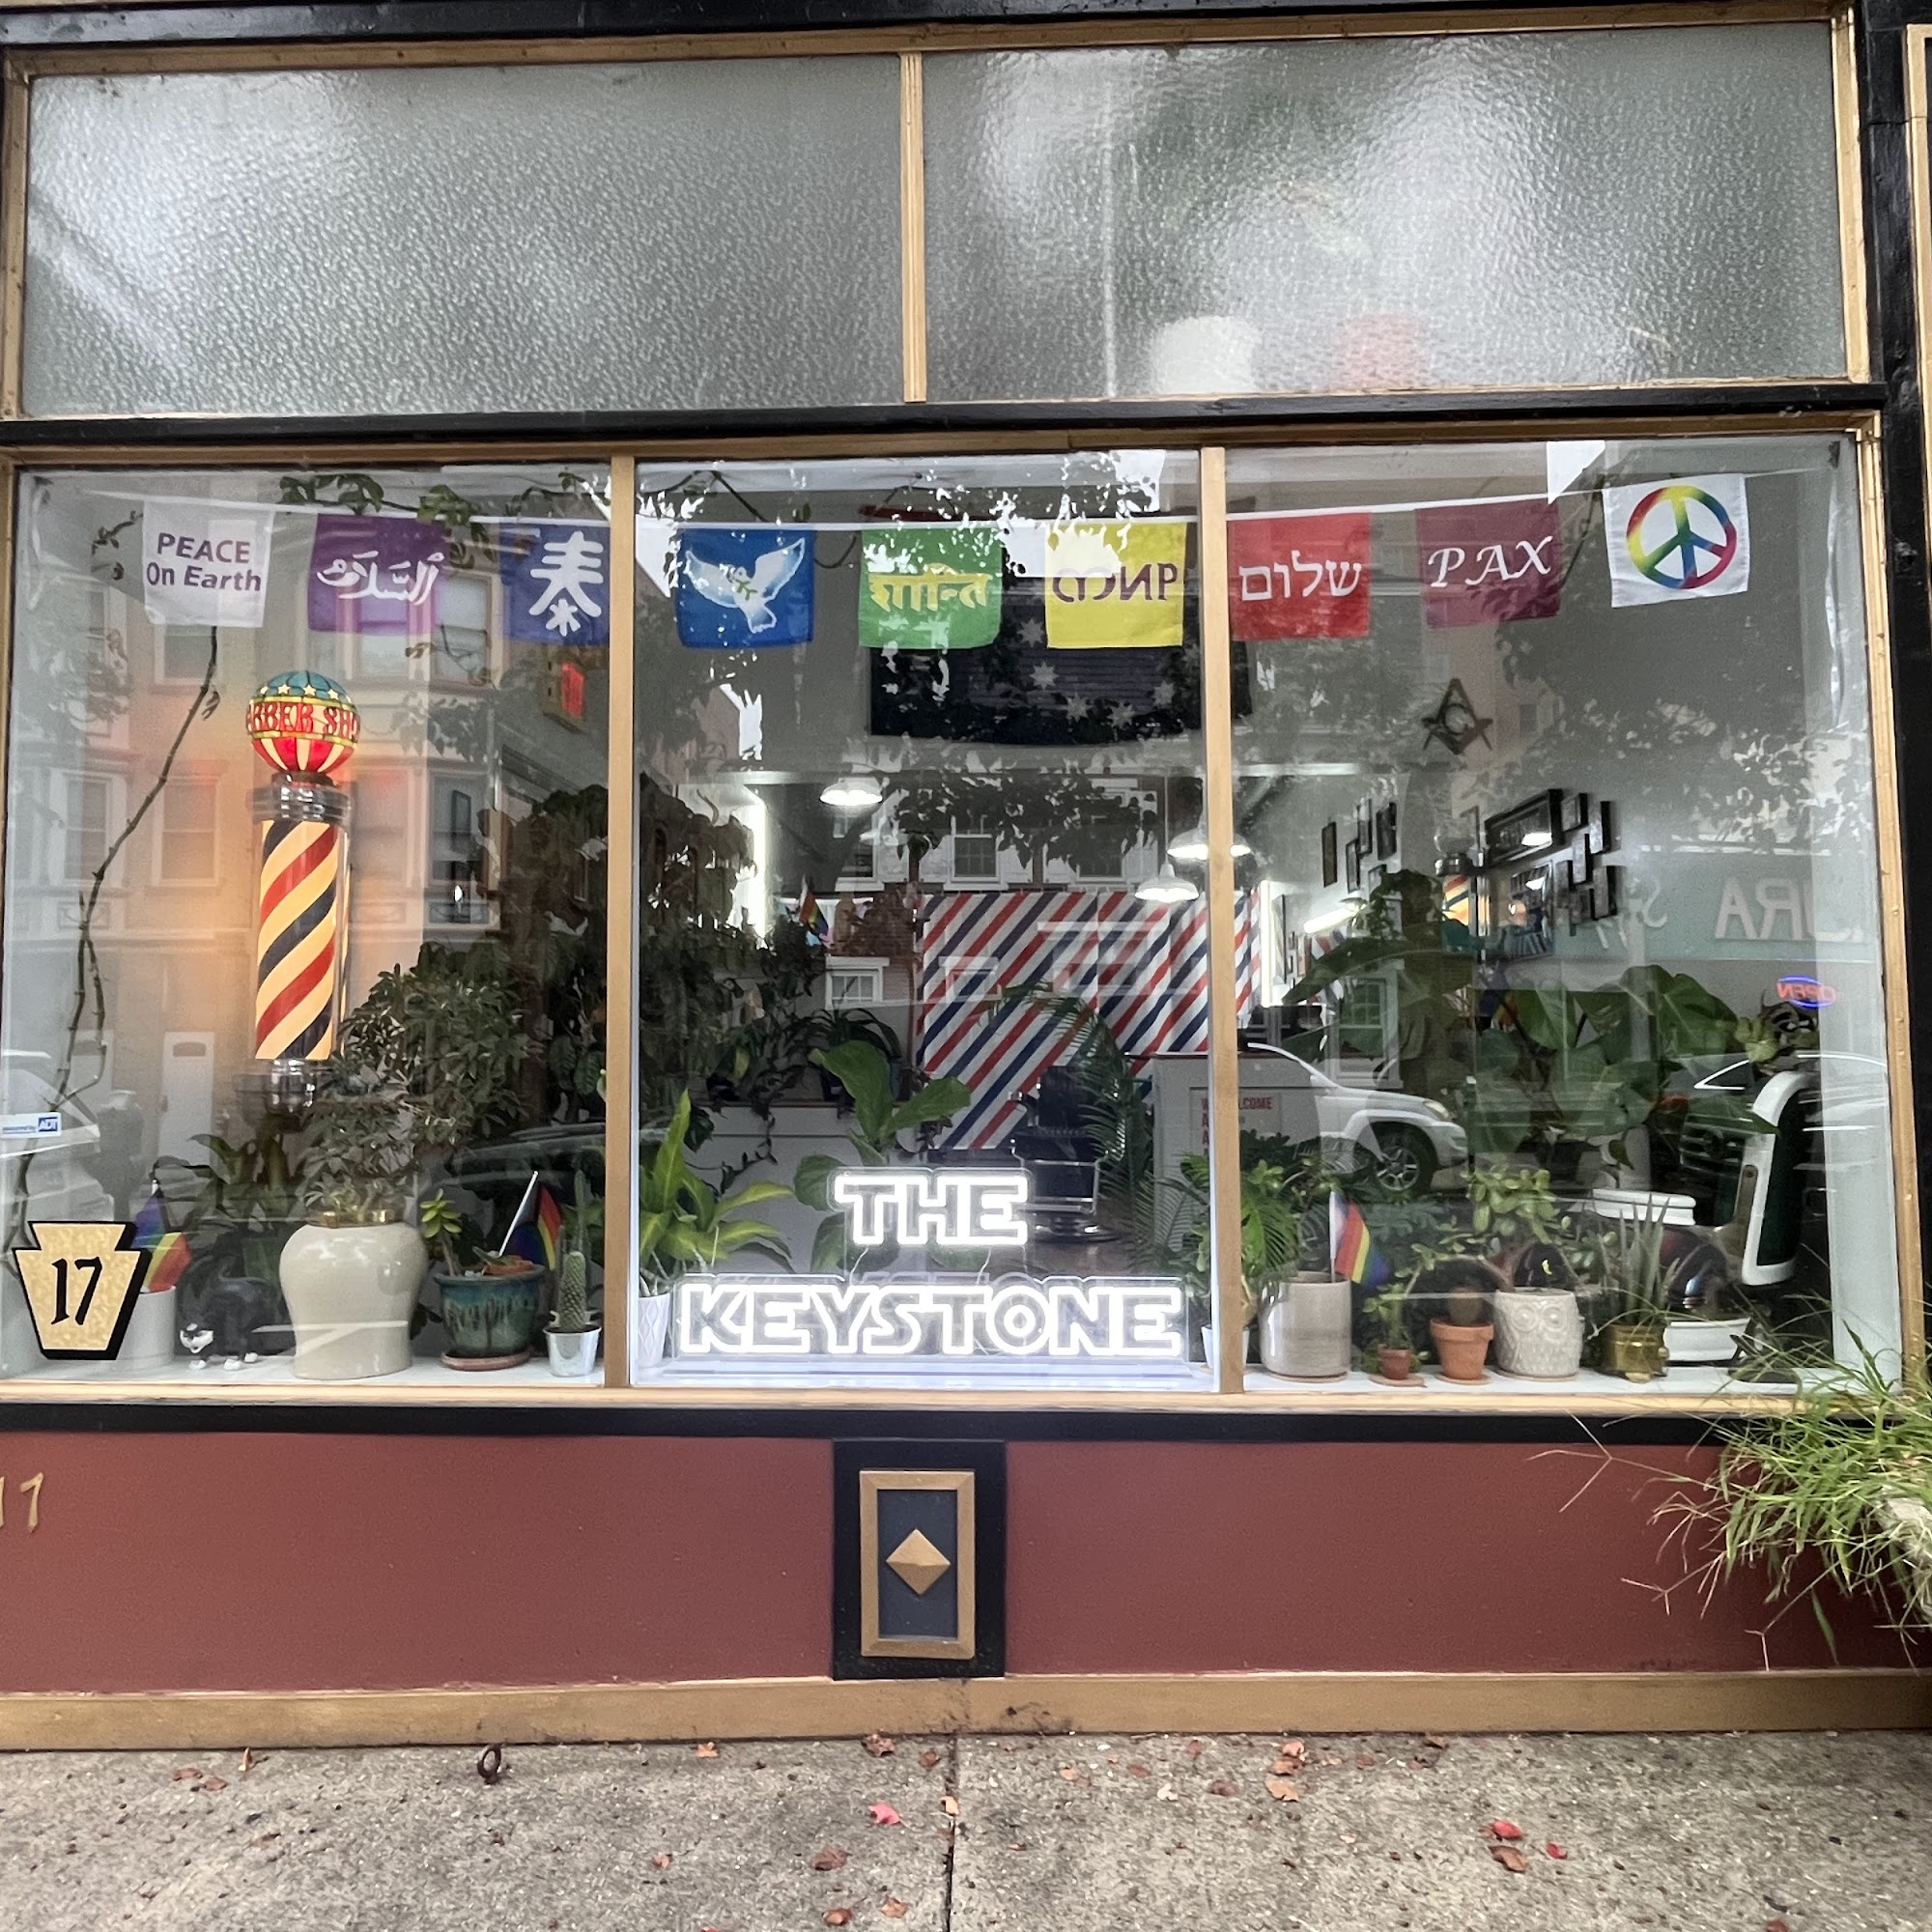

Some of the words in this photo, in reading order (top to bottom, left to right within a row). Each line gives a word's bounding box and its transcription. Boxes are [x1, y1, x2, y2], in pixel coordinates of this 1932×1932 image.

[156, 532, 251, 563] PEACE
[1428, 535, 1553, 588] PAX
[146, 561, 176, 585] On
[184, 564, 262, 591] Earth
[1238, 550, 1363, 601] שלום
[39, 1117, 58, 1132] ADT
[834, 1175, 1028, 1246] THE
[51, 1257, 103, 1325] 17
[679, 1284, 1183, 1356] KEYSTONE
